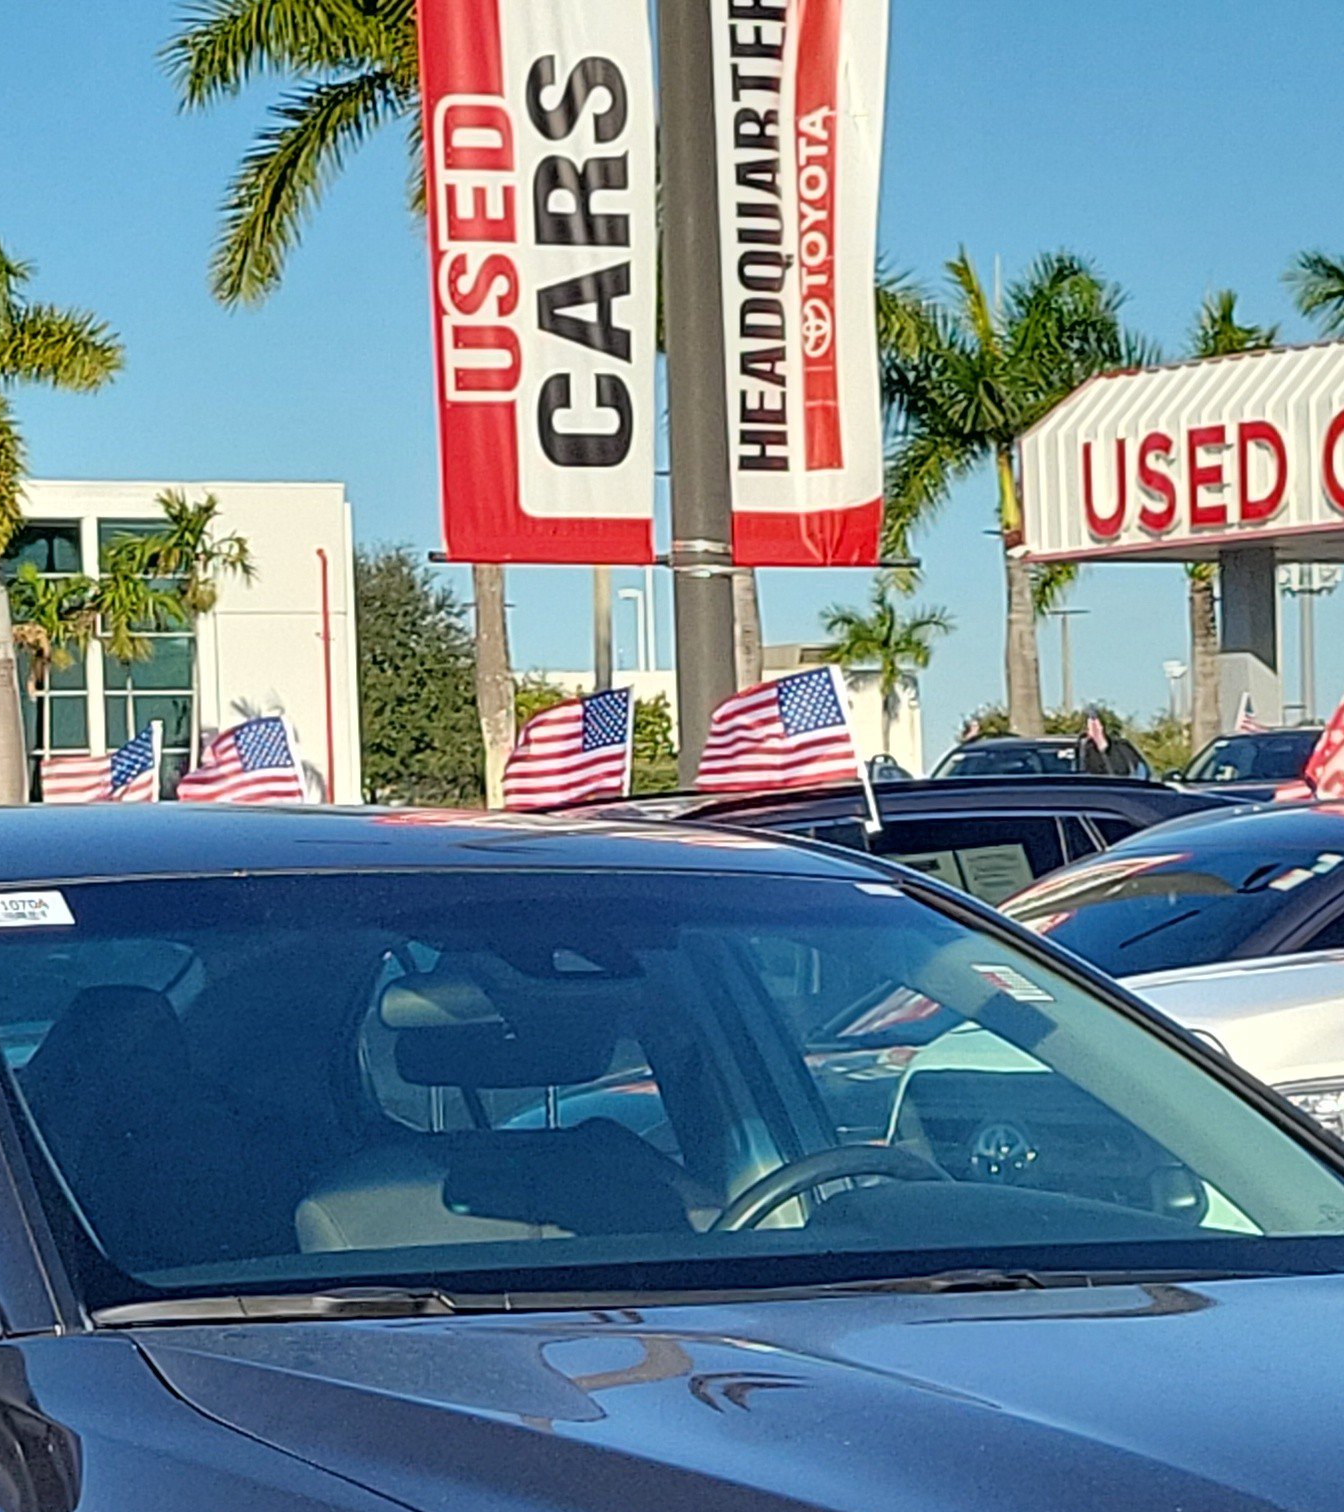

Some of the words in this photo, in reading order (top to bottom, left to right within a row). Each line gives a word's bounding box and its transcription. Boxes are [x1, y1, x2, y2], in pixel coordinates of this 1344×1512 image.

[440, 102, 524, 395] USED
[525, 54, 634, 468] CARS
[798, 105, 830, 295] TOYOTA
[1082, 420, 1288, 539] USED
